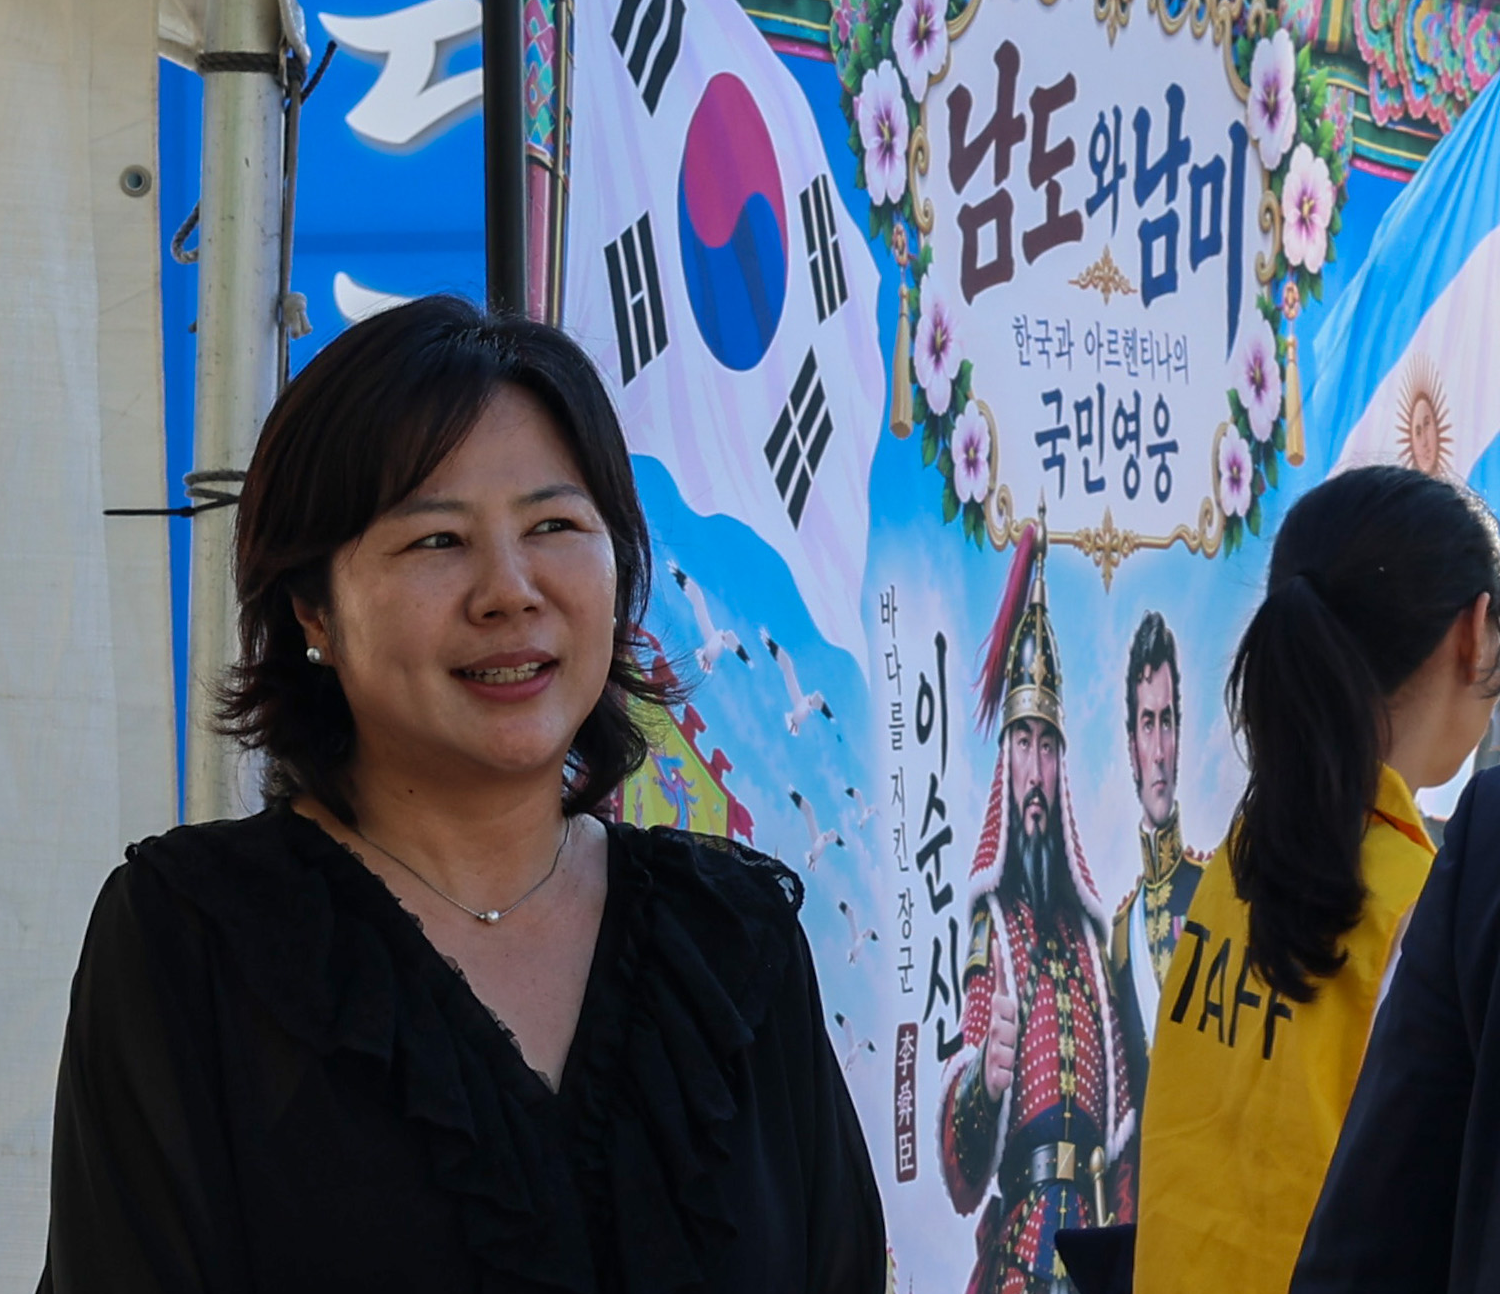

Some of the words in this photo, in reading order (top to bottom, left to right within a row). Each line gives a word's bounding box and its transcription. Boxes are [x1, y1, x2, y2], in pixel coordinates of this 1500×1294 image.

[1011, 313, 1075, 372] 한국과
[1084, 320, 1190, 385] 아르헨티나의
[1034, 381, 1179, 504] 국민영웅
[879, 584, 905, 752] 바다를
[889, 765, 910, 872] 지킨
[915, 630, 964, 1063] 이순신
[896, 887, 915, 994] 장군
